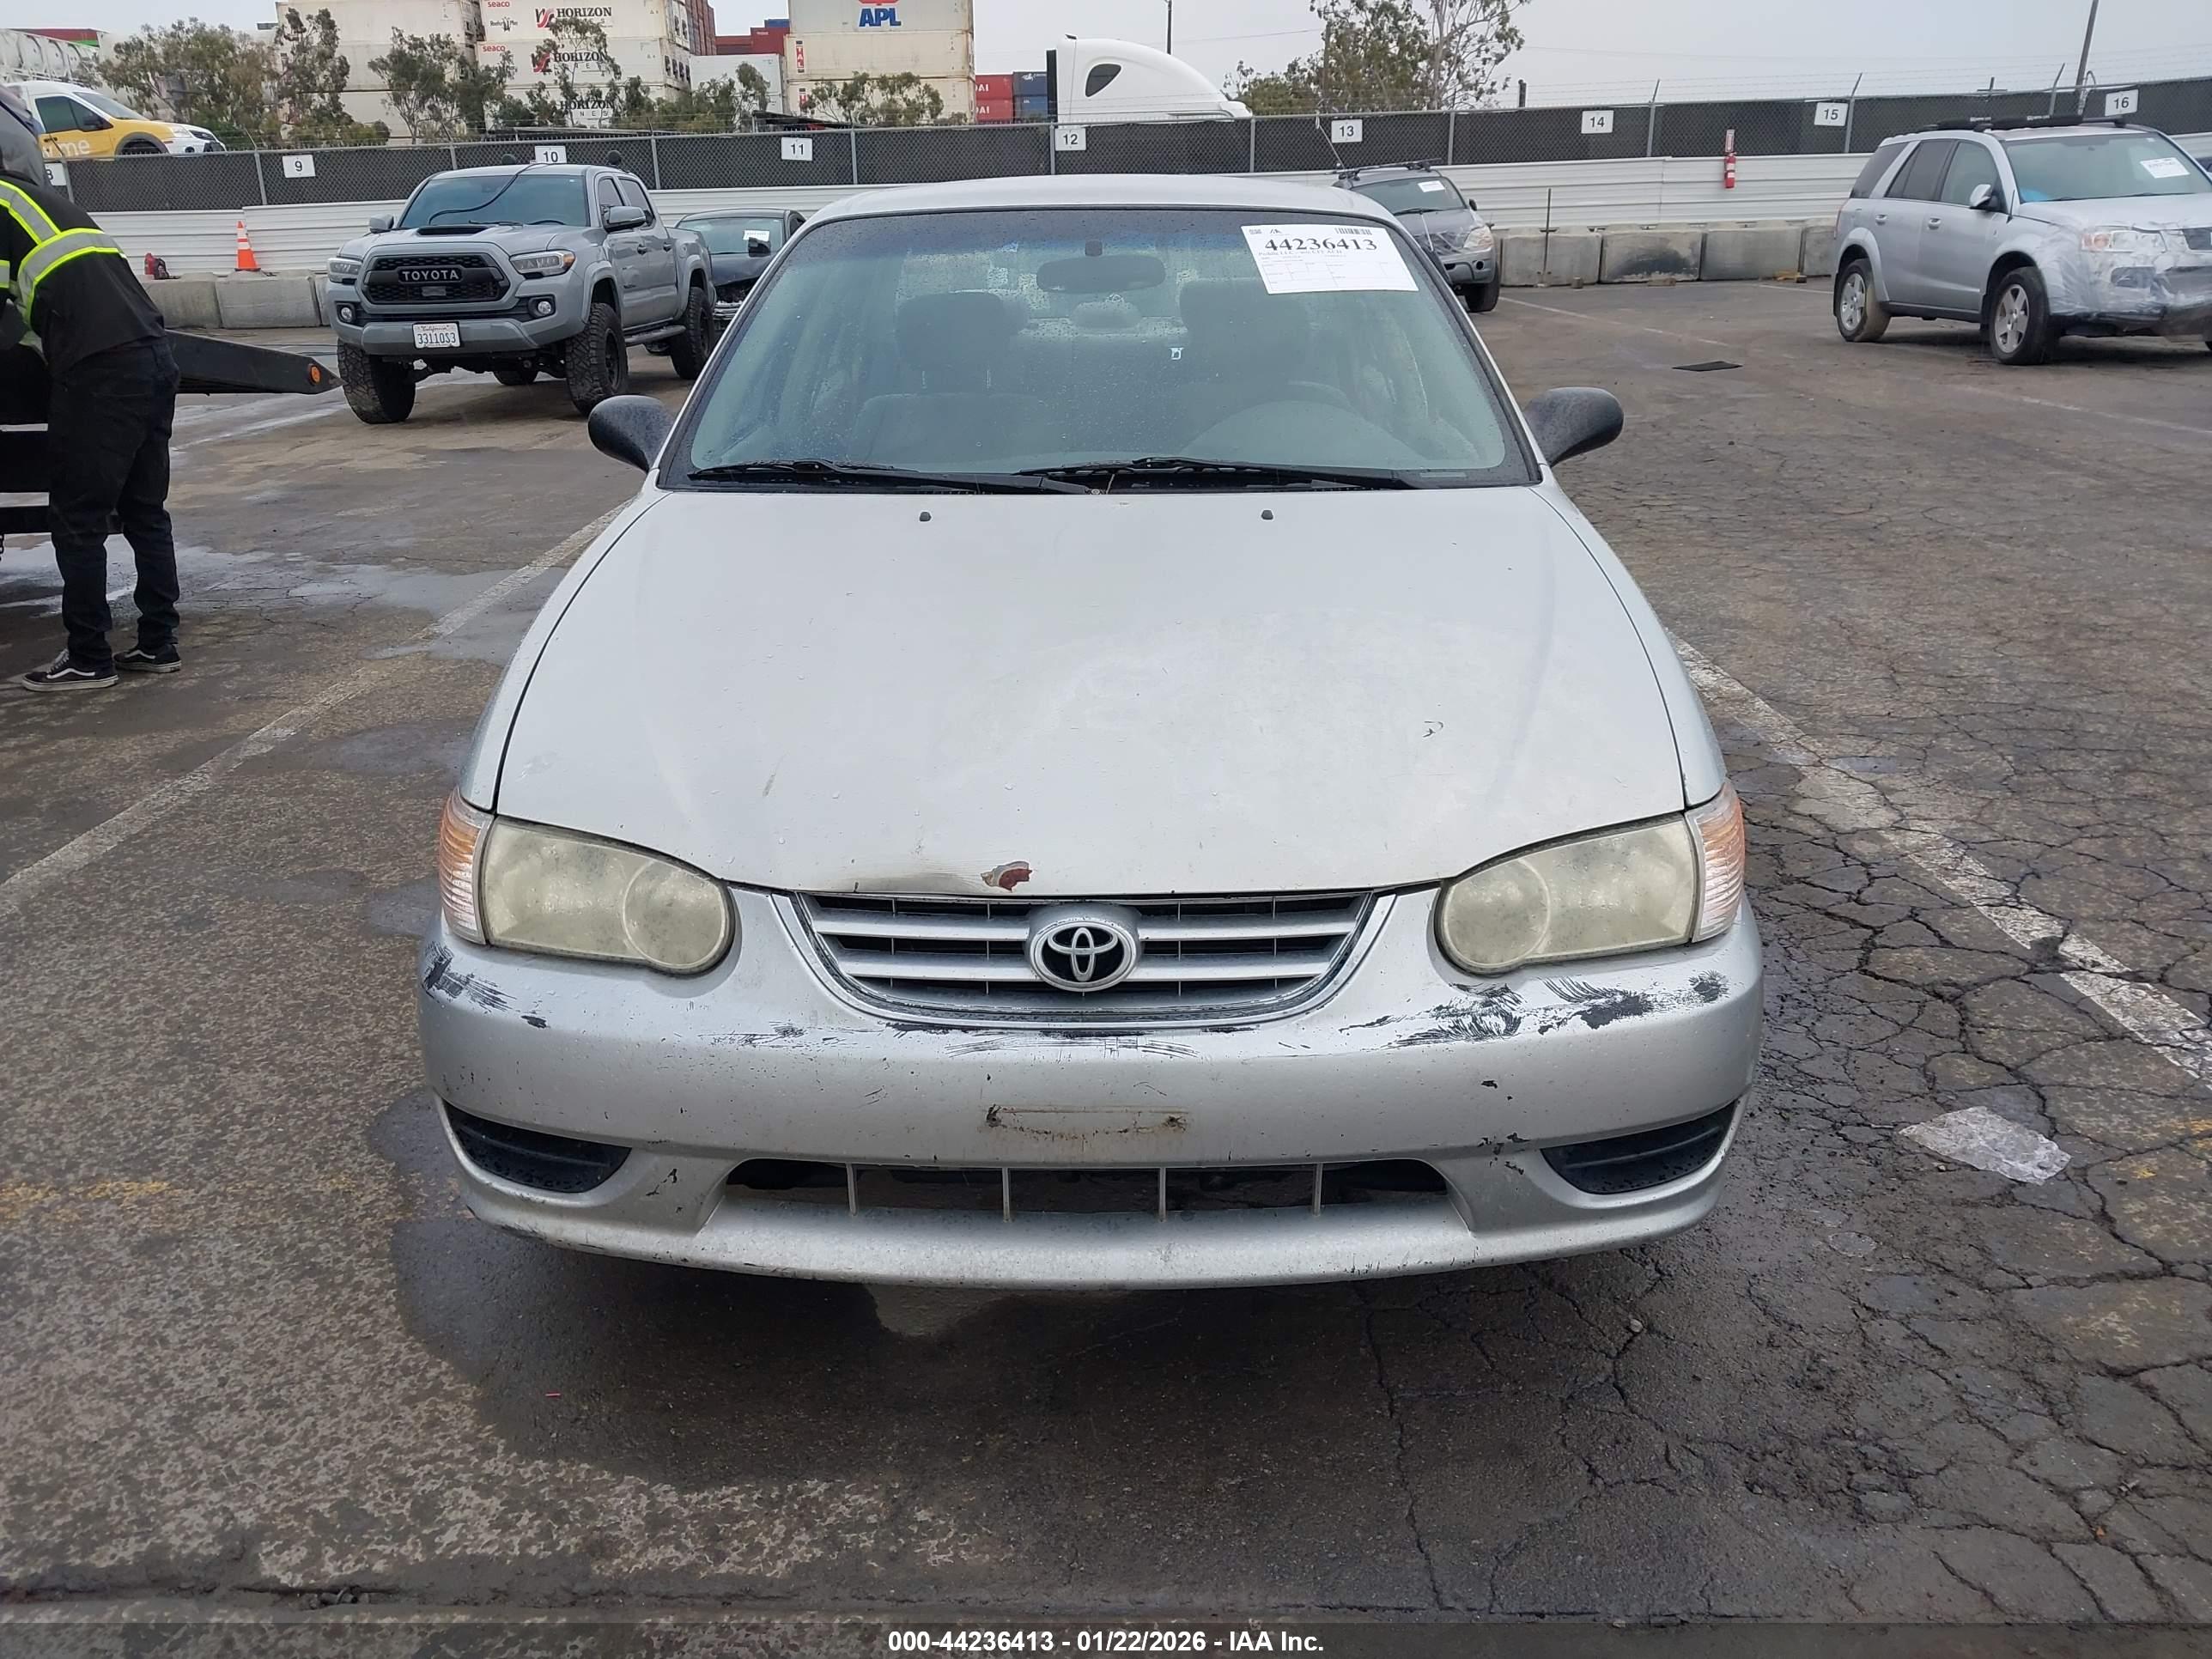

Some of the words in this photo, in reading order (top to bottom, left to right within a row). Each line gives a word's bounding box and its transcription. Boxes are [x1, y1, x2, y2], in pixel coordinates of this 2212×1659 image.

[556, 7, 612, 17] HORIZON
[859, 8, 902, 27] APL
[2113, 96, 2129, 109] 16
[1823, 108, 1838, 120] 15
[1589, 116, 1605, 128] 14
[1339, 125, 1354, 137] 13
[1063, 133, 1078, 145] 12
[791, 143, 804, 155] 11
[544, 151, 558, 163] 10
[295, 161, 303, 172] 9
[1264, 238, 1378, 251] 44236413
[402, 270, 459, 282] TOYOTA
